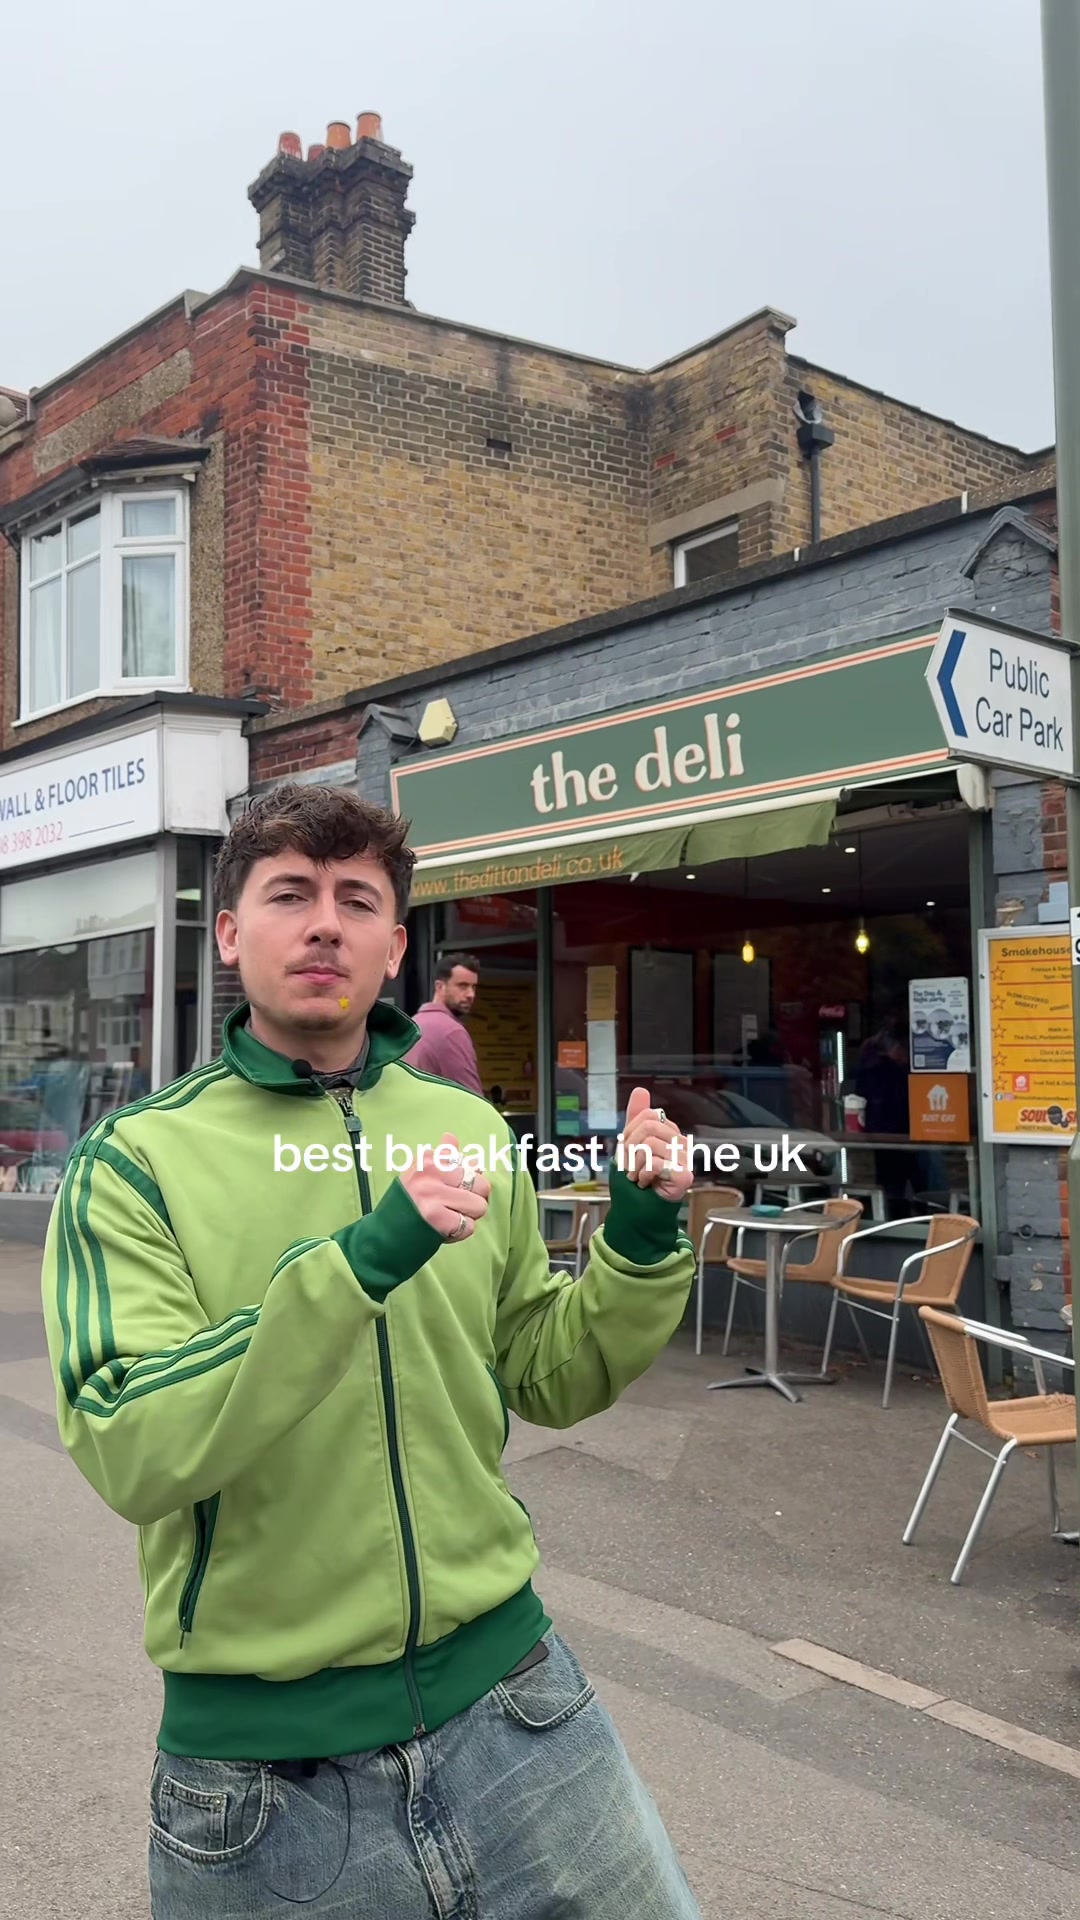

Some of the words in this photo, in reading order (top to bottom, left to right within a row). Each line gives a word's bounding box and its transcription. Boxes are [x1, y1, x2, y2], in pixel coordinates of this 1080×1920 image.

[989, 647, 1050, 699] Public
[975, 696, 1013, 738] Car
[1019, 707, 1064, 752] Park
[35, 788, 45, 811] &
[48, 772, 98, 808] FLOOR
[102, 758, 145, 792] TILES
[530, 750, 619, 814] the
[634, 712, 745, 792] deli
[12, 829, 32, 853] 398
[35, 821, 63, 846] 2032
[1020, 1109, 1049, 1123] SOUL
